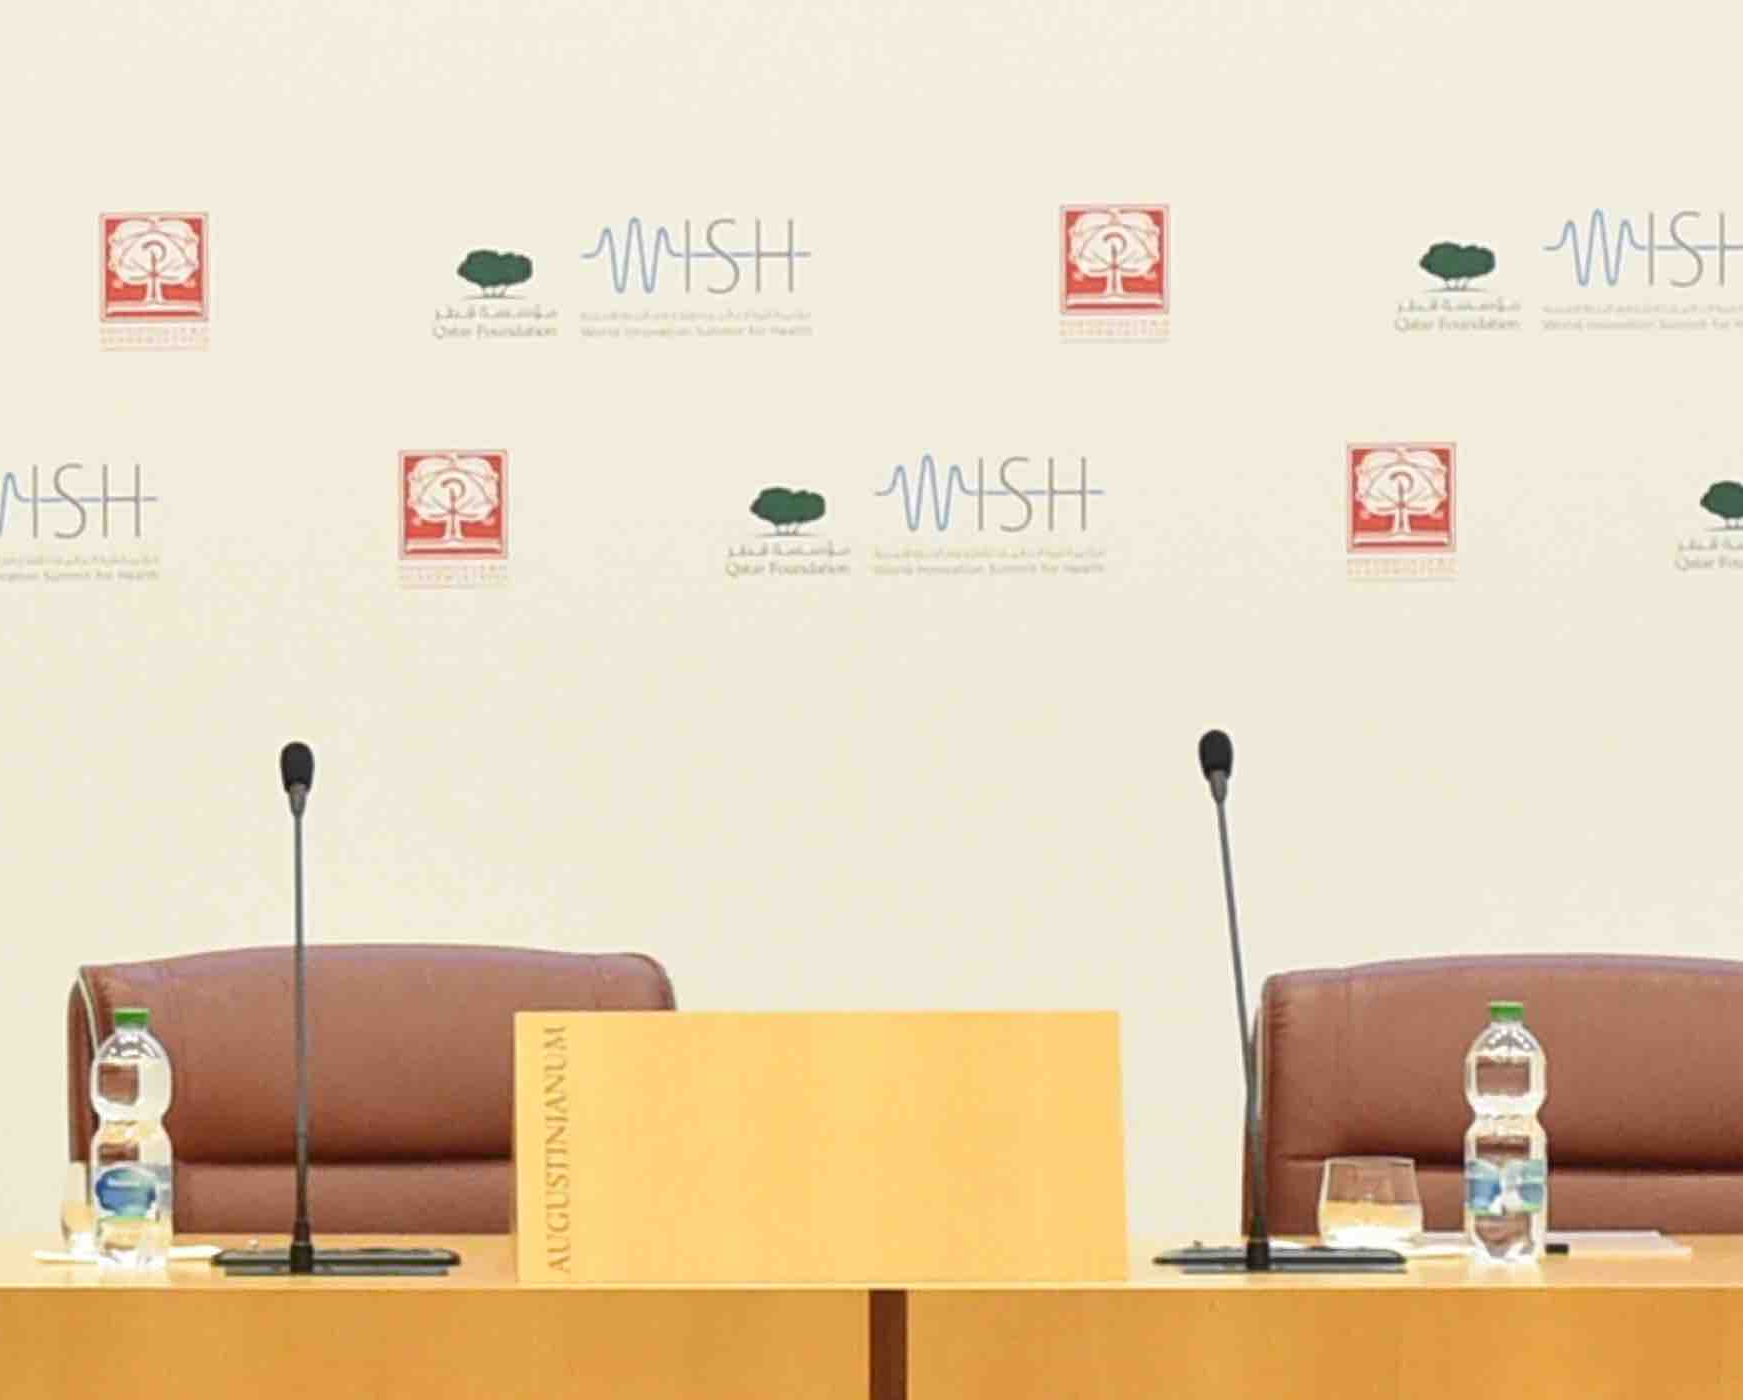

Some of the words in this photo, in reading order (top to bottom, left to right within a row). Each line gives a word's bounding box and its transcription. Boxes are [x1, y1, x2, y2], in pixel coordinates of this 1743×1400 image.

[581, 217, 811, 294] WISH
[874, 453, 1104, 532] WISH
[543, 1024, 571, 1272] AUGUSTINIANUM
